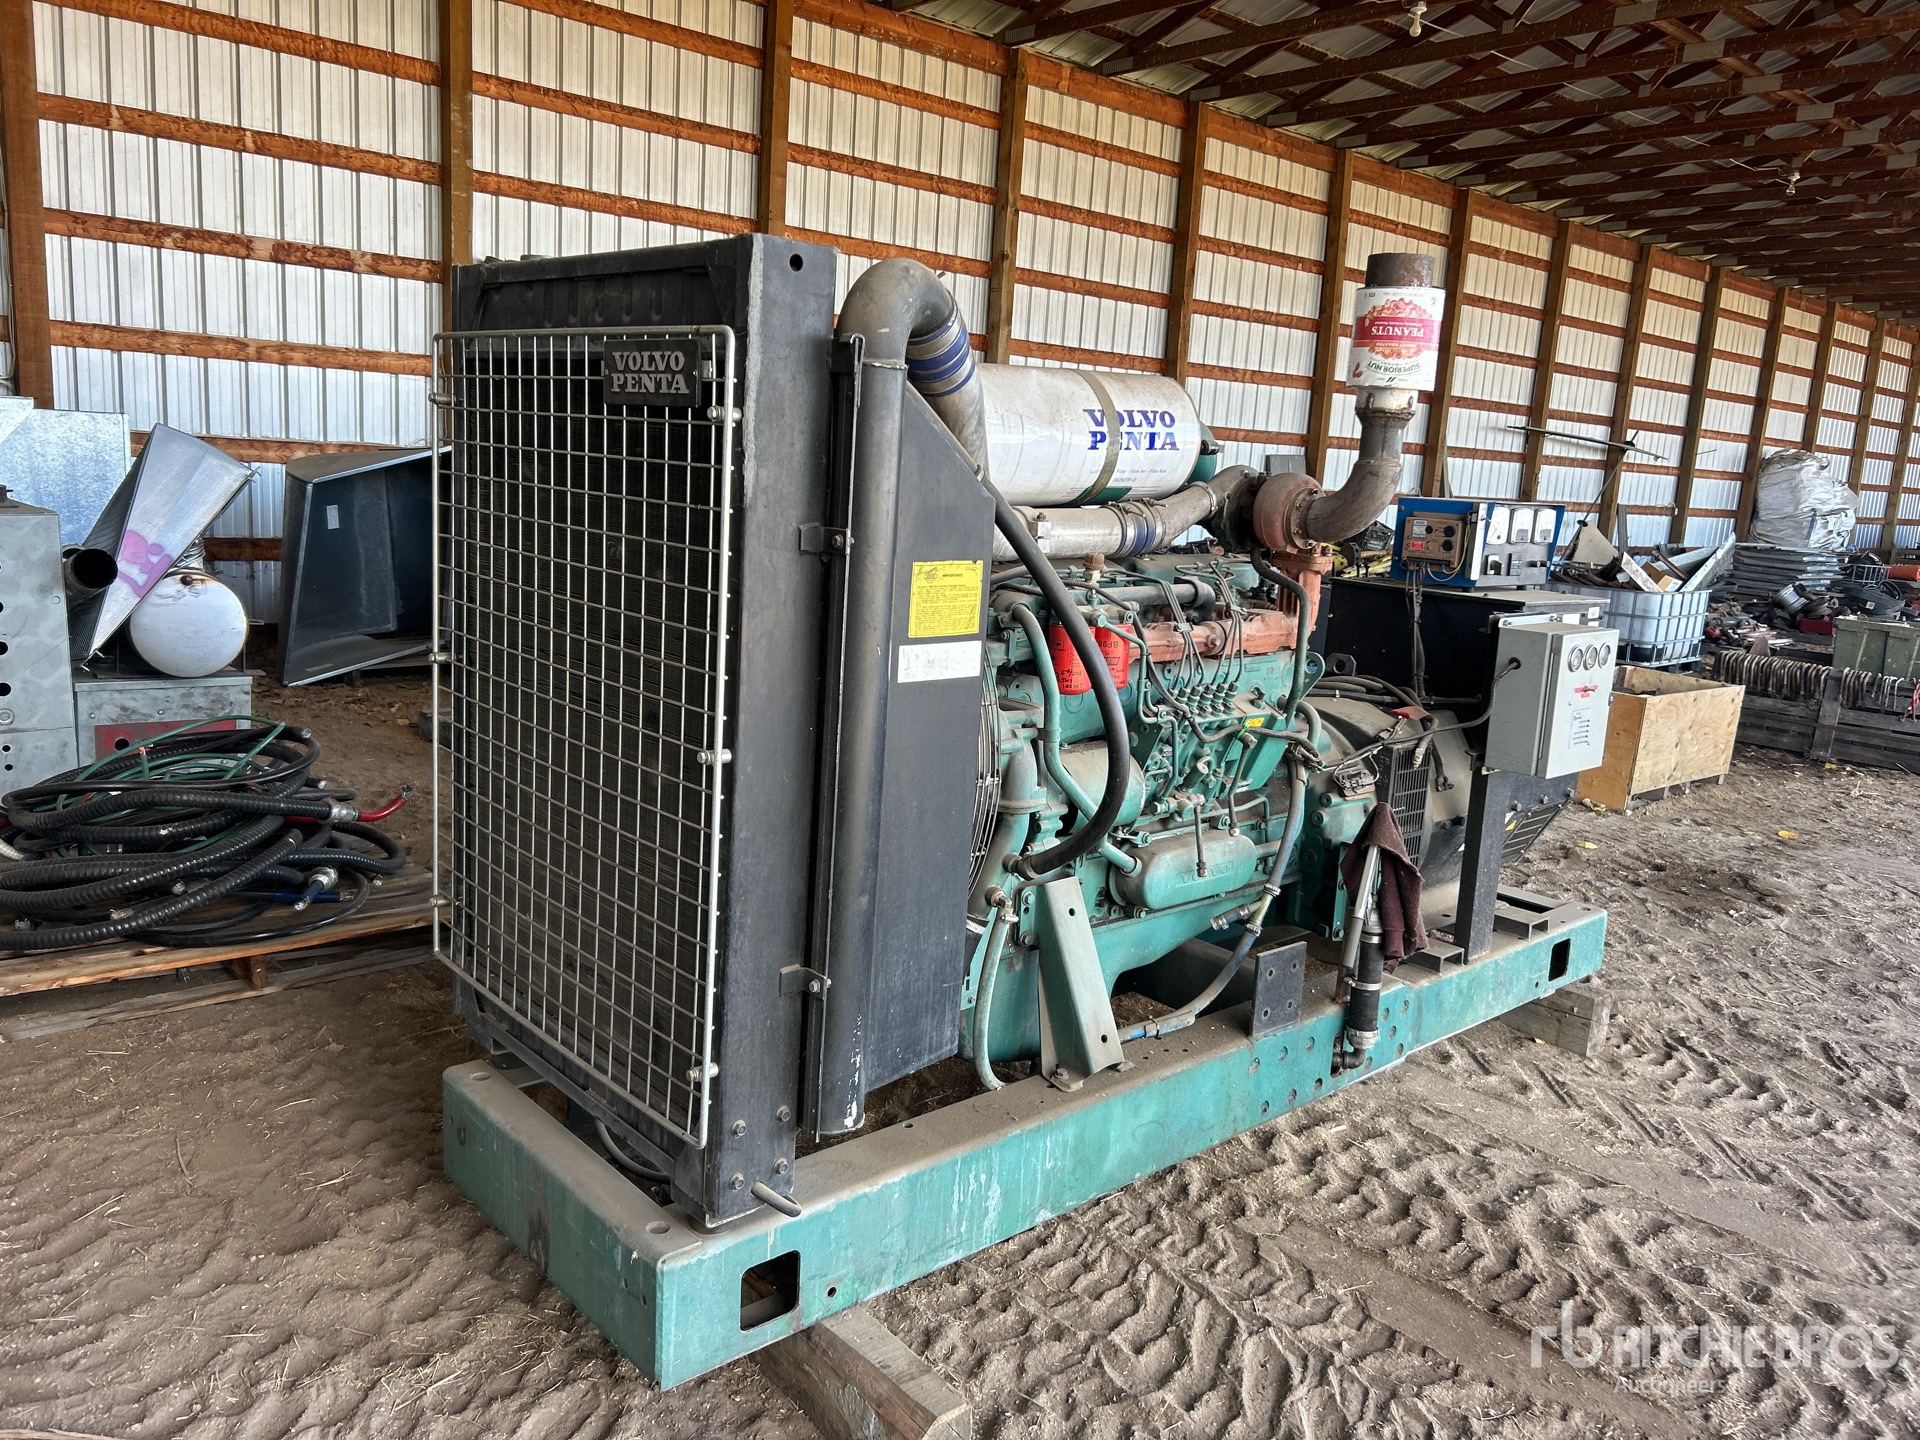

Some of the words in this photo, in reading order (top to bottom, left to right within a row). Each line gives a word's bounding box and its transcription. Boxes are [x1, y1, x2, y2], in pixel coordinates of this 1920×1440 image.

[1371, 326, 1424, 337] PEANUTS
[612, 351, 685, 371] VOLVO
[1367, 361, 1382, 371] NUT
[1383, 363, 1420, 373] SUPERIOR
[611, 373, 689, 393] PENTA
[1087, 431, 1179, 450] PNTA
[1180, 864, 1228, 883] VOVO
